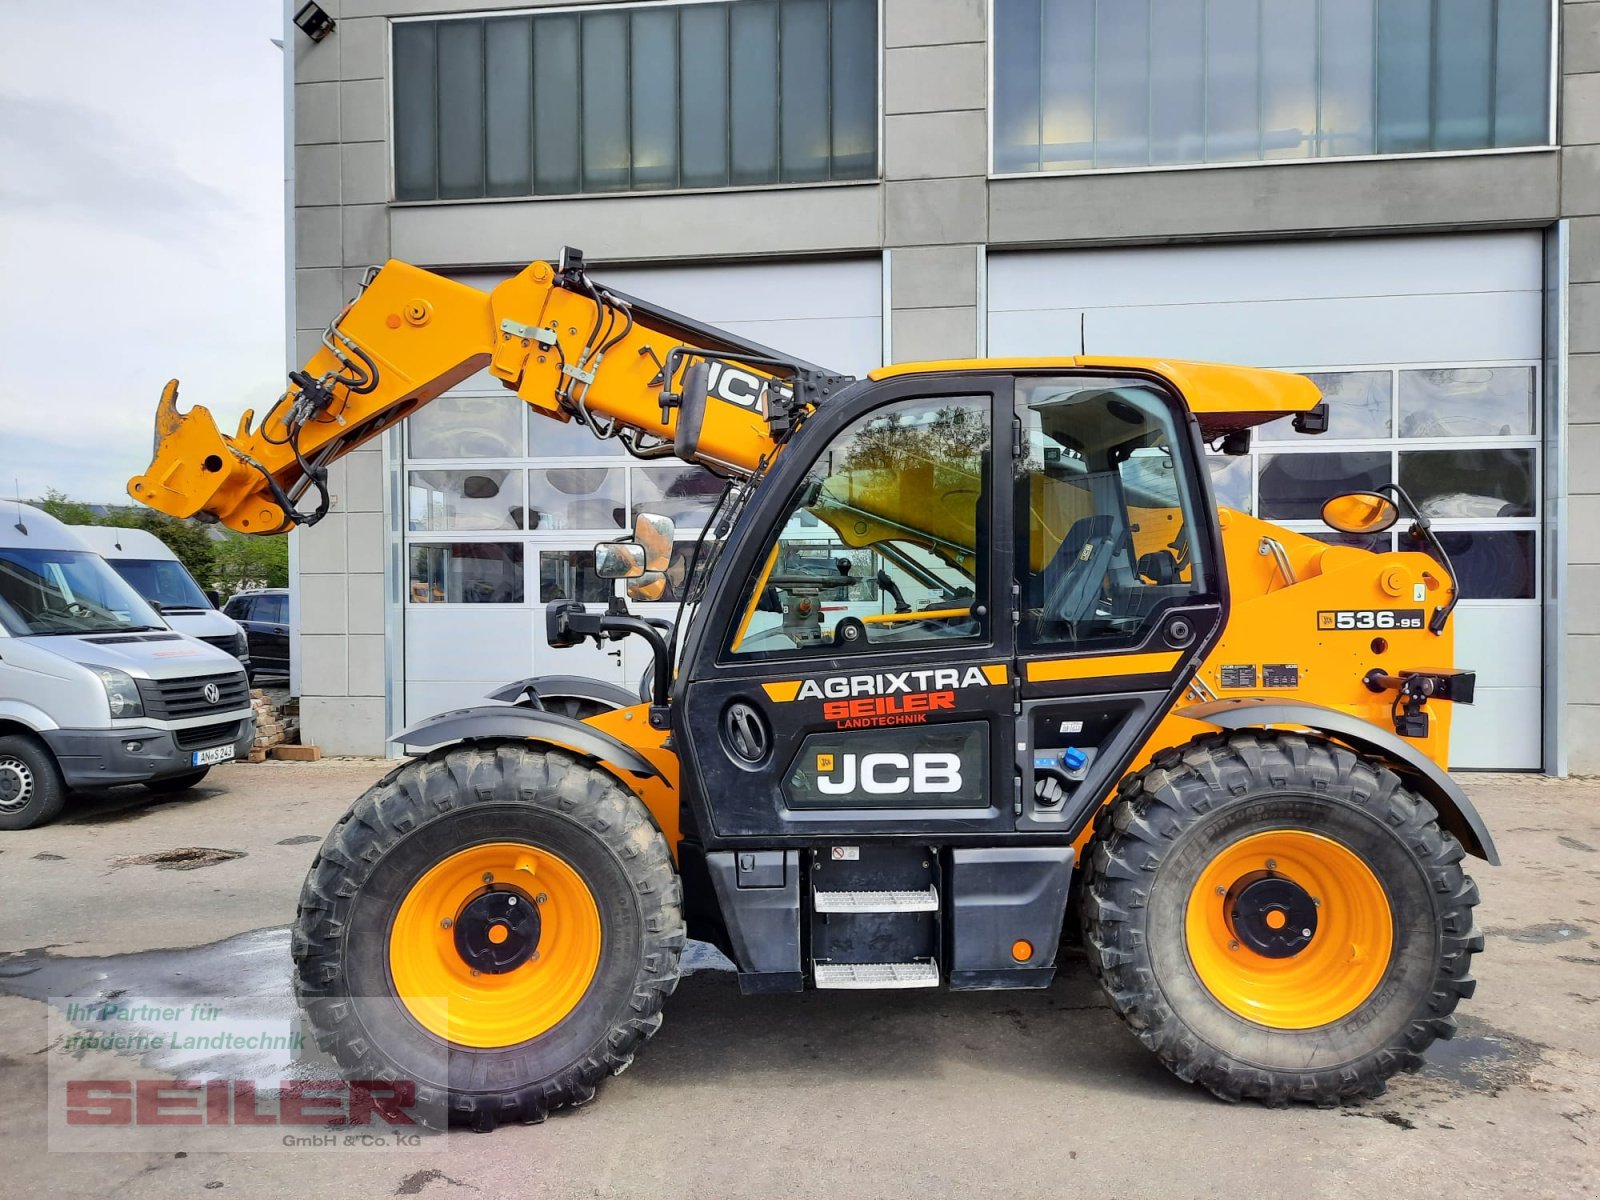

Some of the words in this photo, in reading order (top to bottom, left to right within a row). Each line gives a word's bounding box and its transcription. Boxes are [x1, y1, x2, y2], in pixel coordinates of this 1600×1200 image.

[1337, 611, 1421, 629] 536-95
[798, 666, 989, 701] AGRIXTRA
[824, 691, 956, 720] SEILER
[837, 713, 927, 730] LANDTECHNIK
[817, 753, 963, 795] JCB
